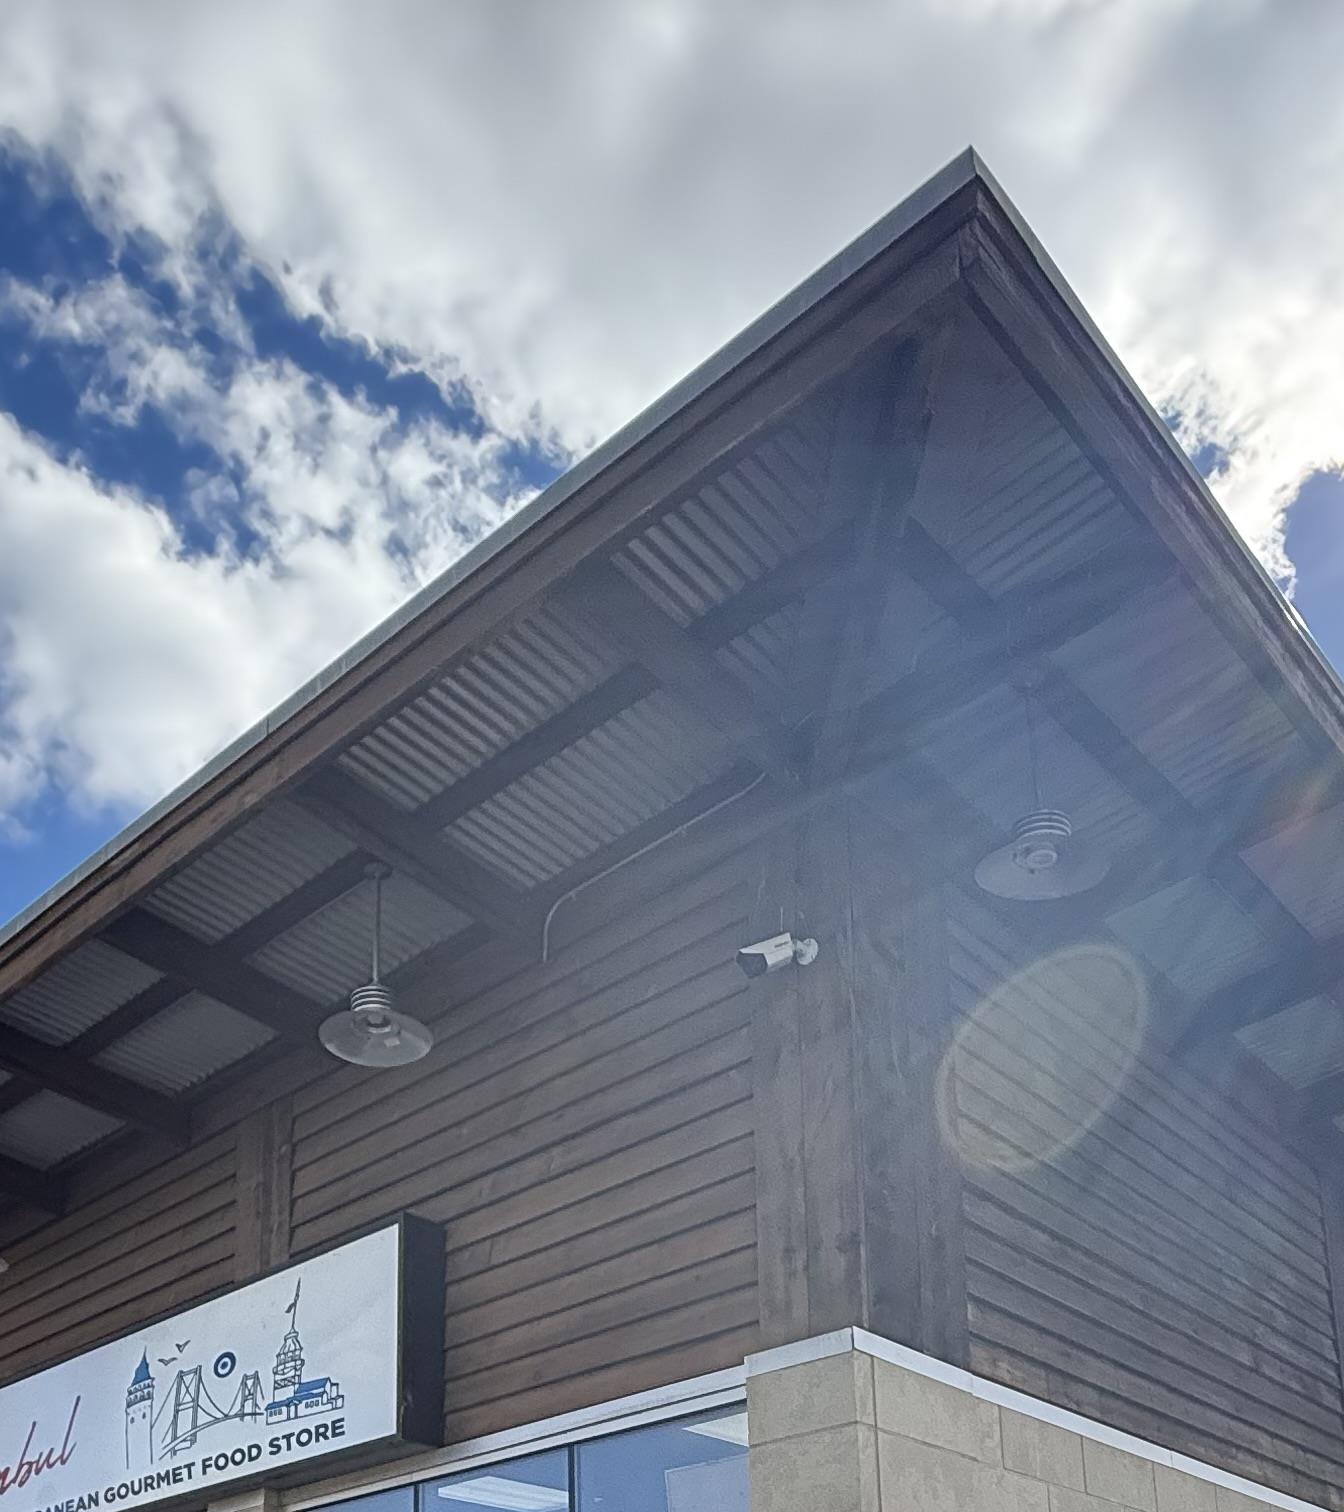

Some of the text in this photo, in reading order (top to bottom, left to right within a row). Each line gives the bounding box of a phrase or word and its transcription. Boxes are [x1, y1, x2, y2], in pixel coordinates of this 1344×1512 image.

[104, 1463, 195, 1504] GOURMET
[201, 1444, 262, 1475] FOOD
[269, 1418, 346, 1457] STORE
